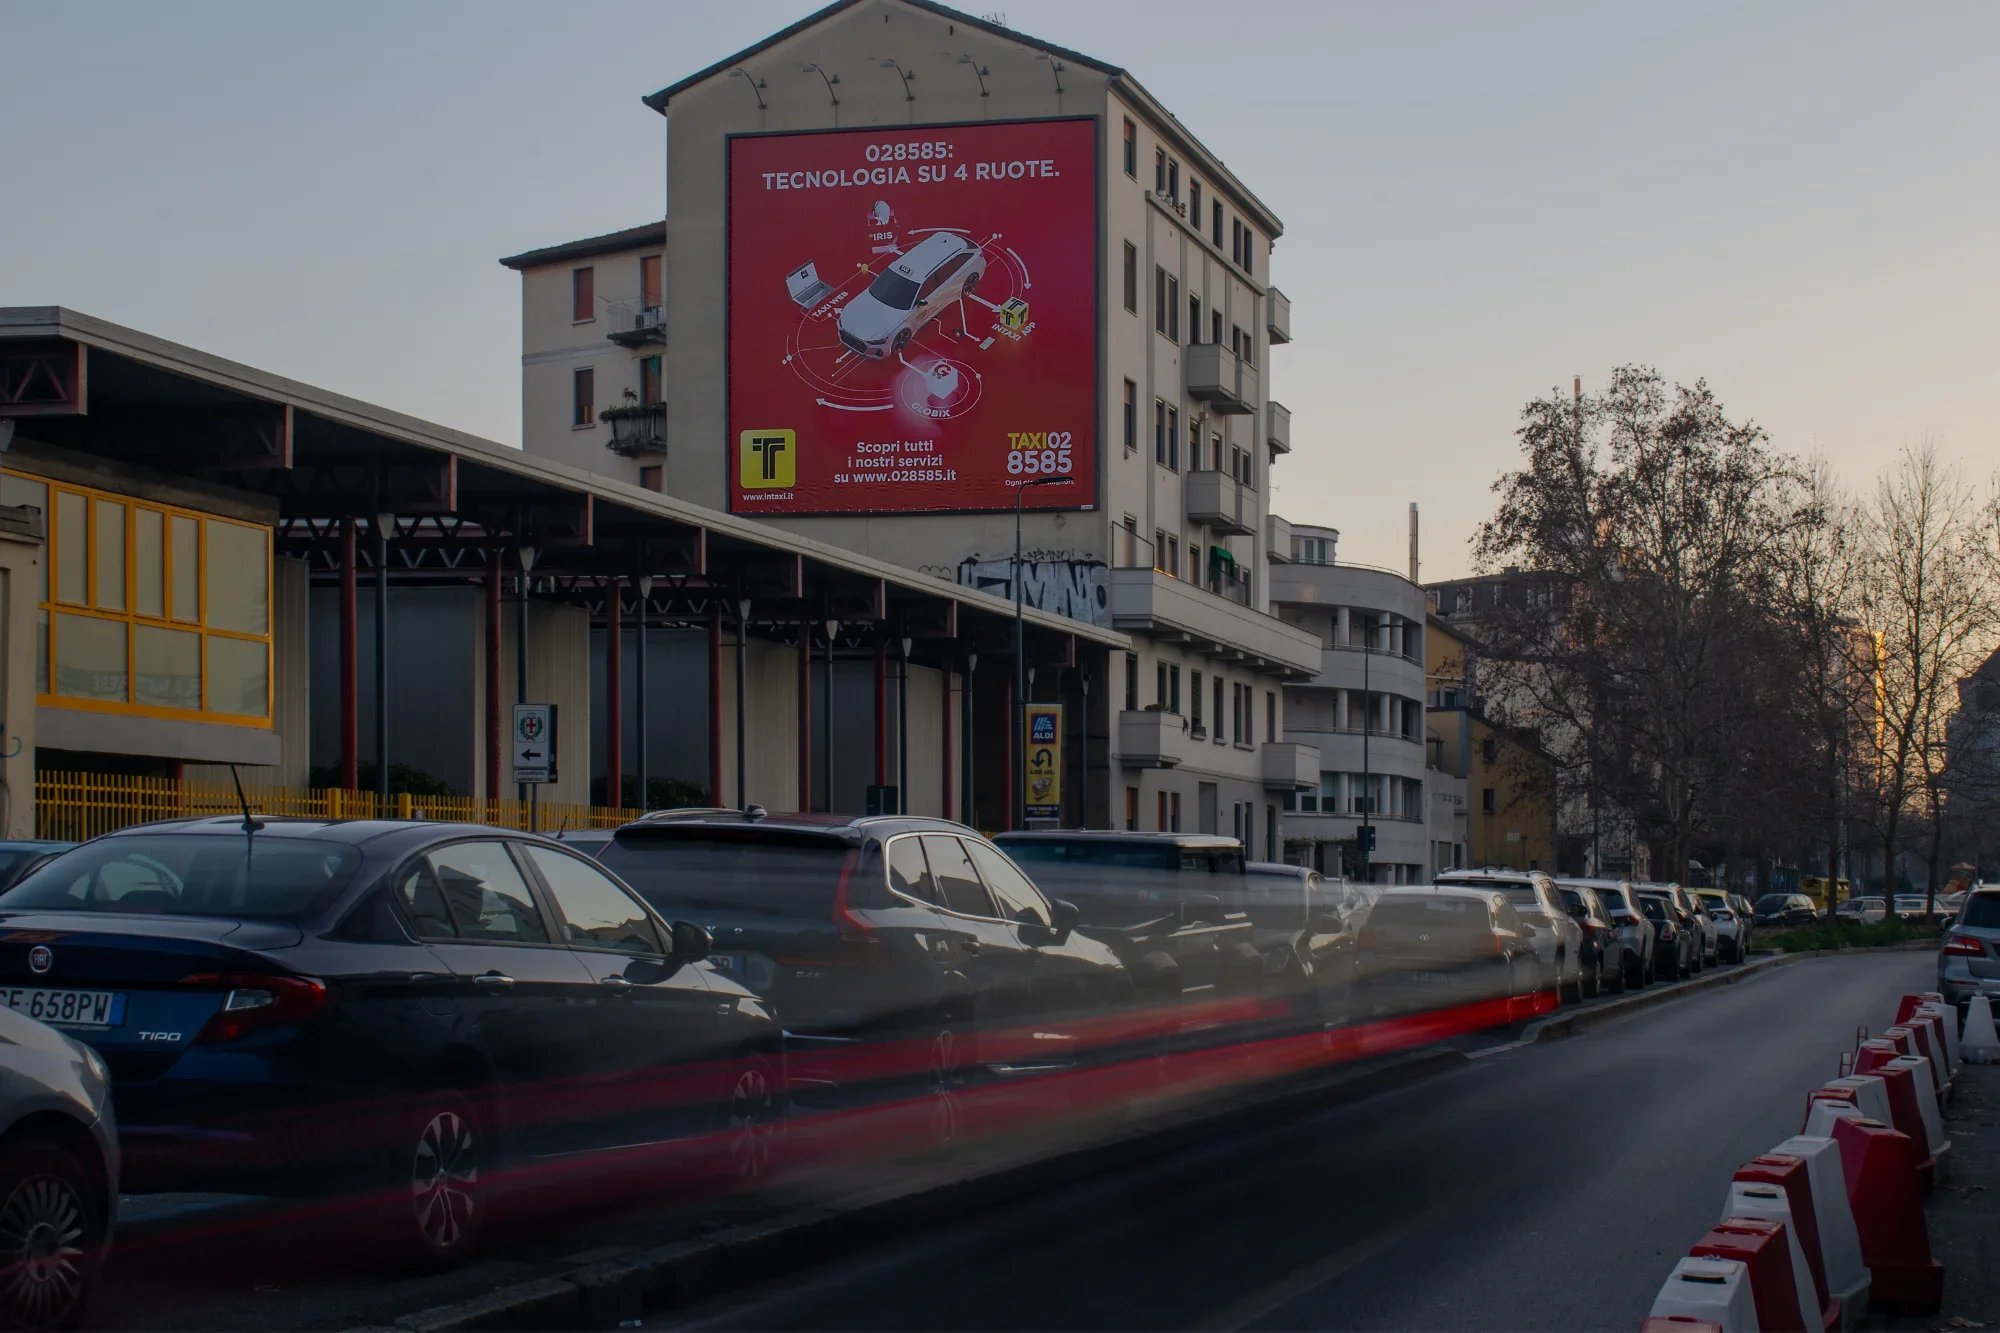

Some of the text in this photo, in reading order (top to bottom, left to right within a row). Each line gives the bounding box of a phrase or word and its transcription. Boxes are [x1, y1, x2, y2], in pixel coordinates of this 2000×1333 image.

[866, 142, 953, 162] 028585:
[762, 160, 1060, 190] TECNOLOGIA SU 4 RUOTE.
[873, 231, 893, 241] IRIS
[811, 291, 849, 317] TAXI WEB
[991, 321, 1036, 342] INTAXI APP
[911, 402, 951, 418] GLOBIX
[857, 439, 933, 455] Scopri tutti
[847, 454, 943, 468] i nostri servizi
[1006, 450, 1073, 475] 8585
[834, 469, 957, 483] su www.028585.it
[33, 953, 48, 967] FIAT
[30, 991, 109, 1021] 658PW
[138, 1031, 182, 1041] TIPO
